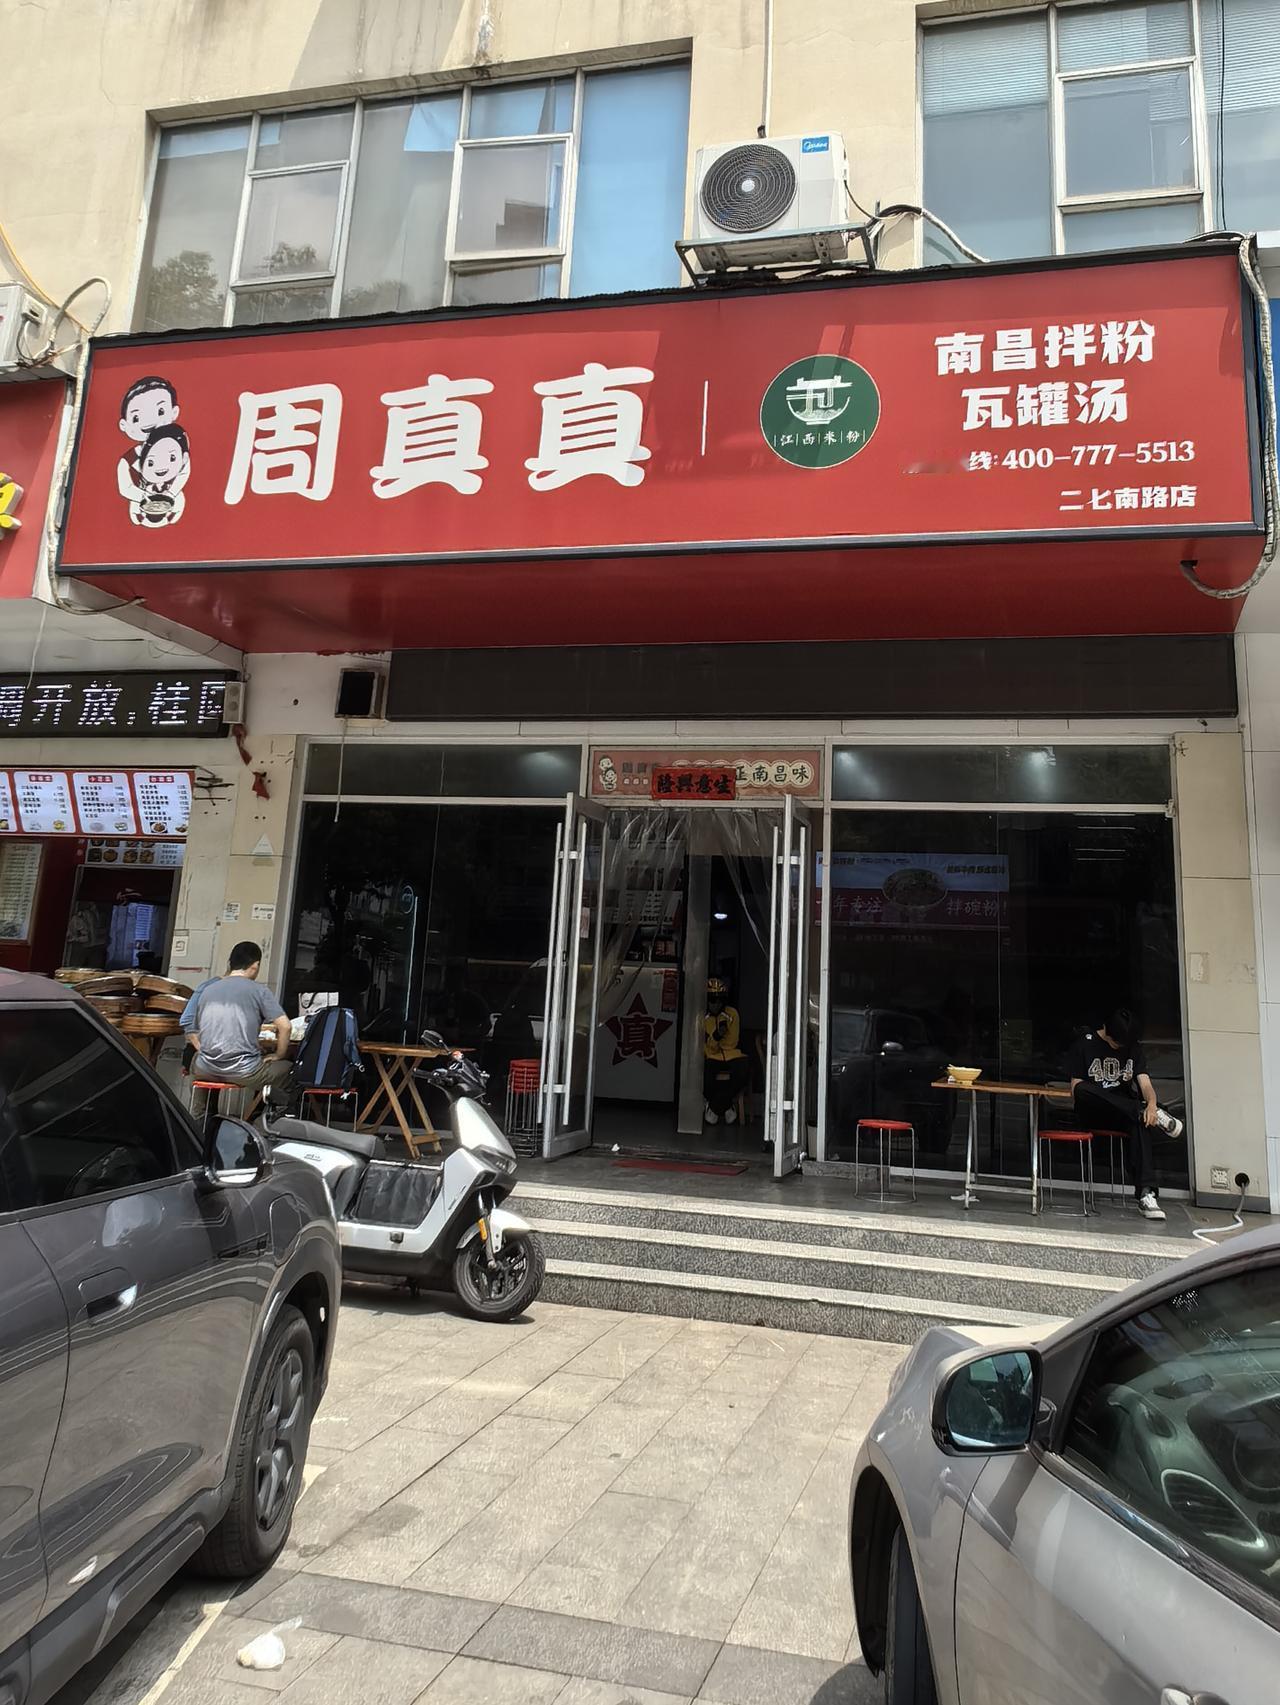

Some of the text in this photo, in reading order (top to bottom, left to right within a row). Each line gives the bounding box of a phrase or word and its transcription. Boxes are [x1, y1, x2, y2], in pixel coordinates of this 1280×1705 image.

[934, 319, 1155, 376] 南昌拌粉
[961, 377, 1129, 431] 瓦罐汤
[224, 362, 655, 505] 周真真
[780, 431, 860, 447] 江西米粉
[1058, 484, 1197, 511] 二七南路店
